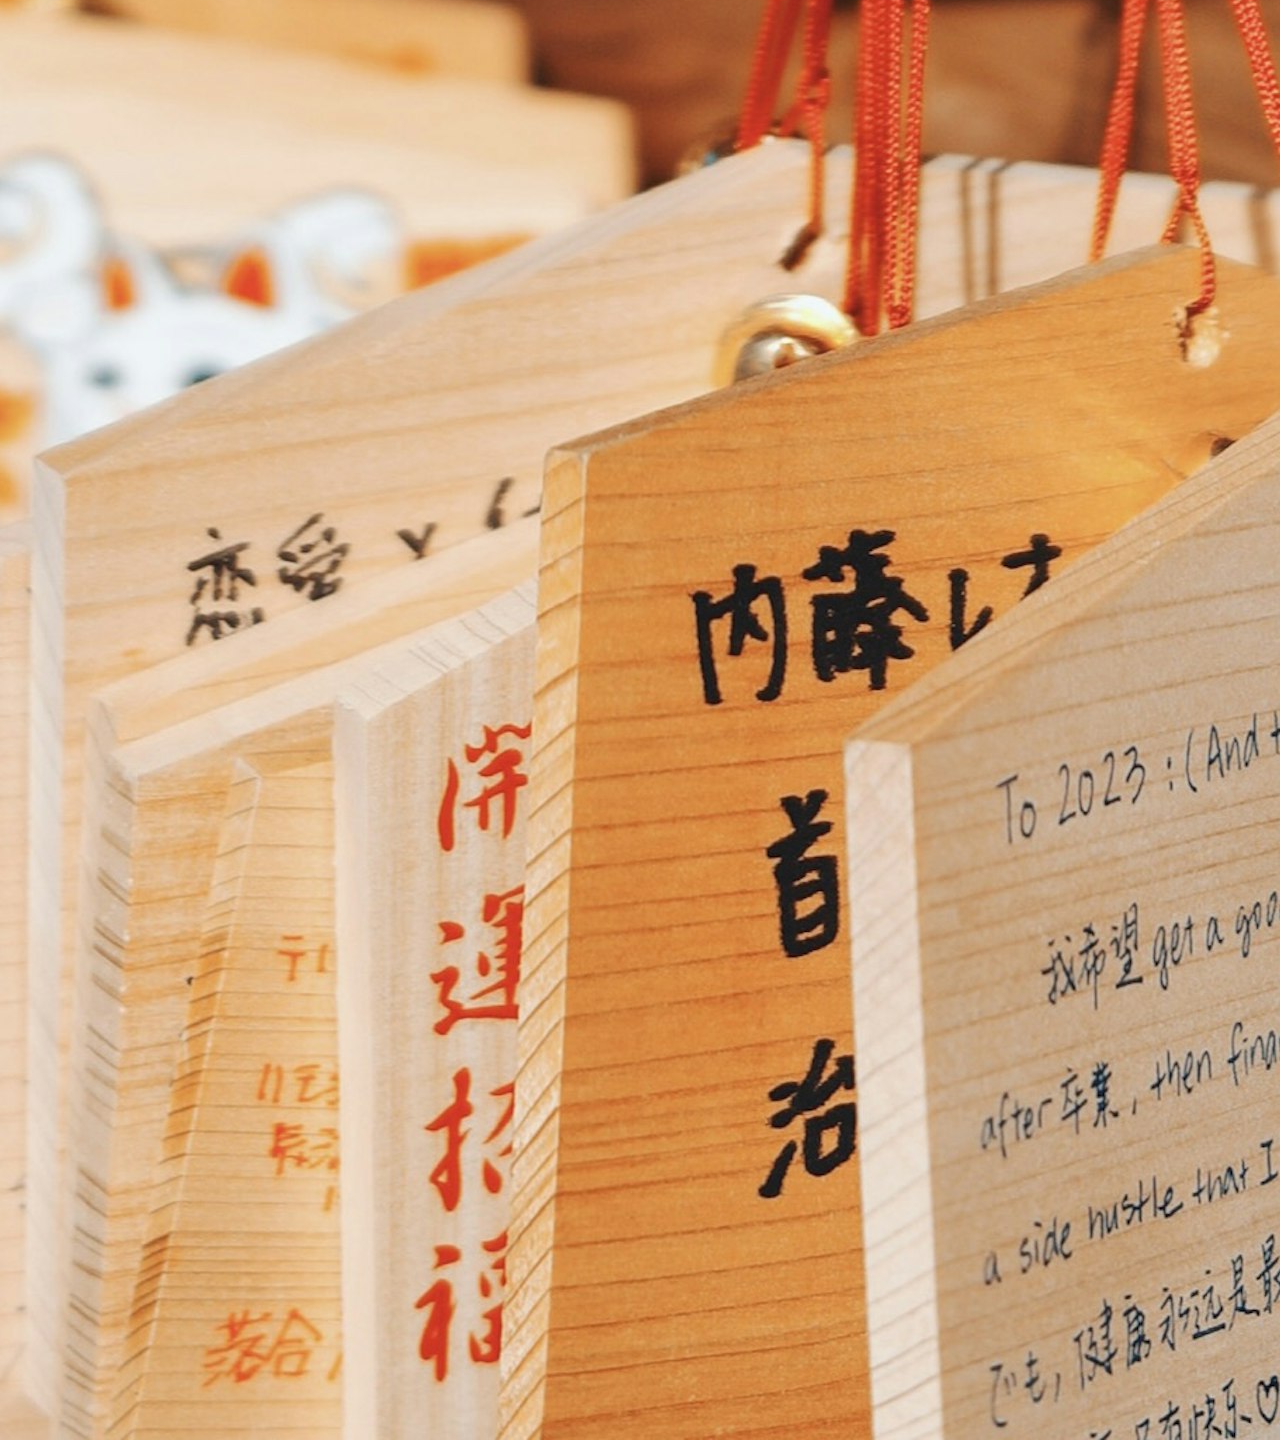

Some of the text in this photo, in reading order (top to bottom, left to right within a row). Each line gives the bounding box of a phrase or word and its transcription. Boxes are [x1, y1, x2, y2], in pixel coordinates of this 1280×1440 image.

[997, 774, 1037, 844] To
[1057, 744, 1146, 826] 2023
[1152, 913, 1194, 991] get
[1205, 914, 1225, 951] a
[979, 1090, 1053, 1160] after
[1150, 1049, 1213, 1102] then
[984, 1251, 1003, 1286] a
[1018, 1220, 1073, 1275] side
[1087, 1175, 1185, 1240] hustle
[1192, 1158, 1249, 1207] that
